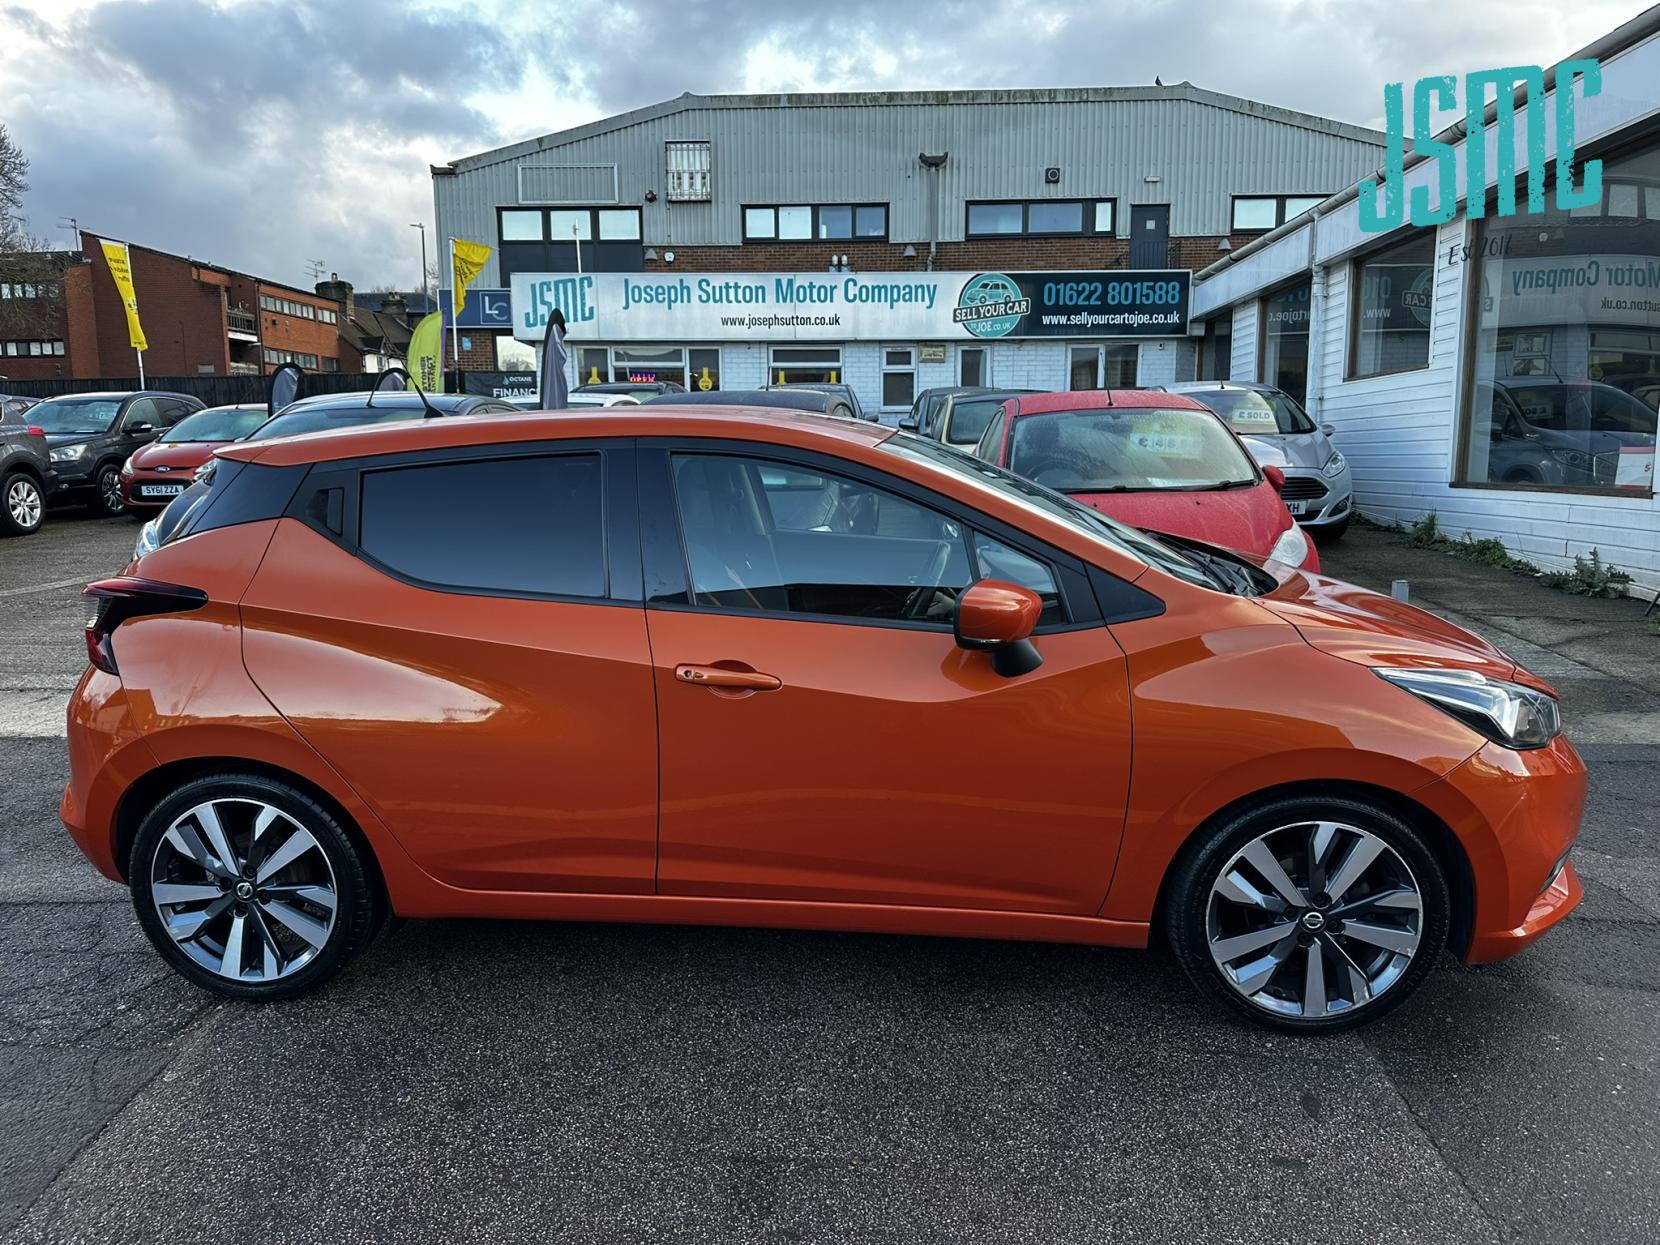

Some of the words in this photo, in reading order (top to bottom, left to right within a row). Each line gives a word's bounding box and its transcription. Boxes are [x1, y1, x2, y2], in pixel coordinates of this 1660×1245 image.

[524, 276, 595, 328] JSMC
[622, 278, 692, 310] Joseph
[697, 278, 766, 304] Sutton
[775, 278, 838, 304] Motor
[843, 277, 938, 309] Company
[1043, 282, 1102, 305] 01622
[1107, 281, 1180, 305] 801588
[955, 307, 978, 321] SELL
[979, 303, 1006, 318] YOUR
[1006, 301, 1028, 314] CAR
[1042, 311, 1180, 328] www.sellyourcartojoe.co.uk
[721, 313, 841, 329] www.josephsutton.co.uk
[1247, 411, 1270, 420] SOLD
[146, 486, 164, 494] SY61
